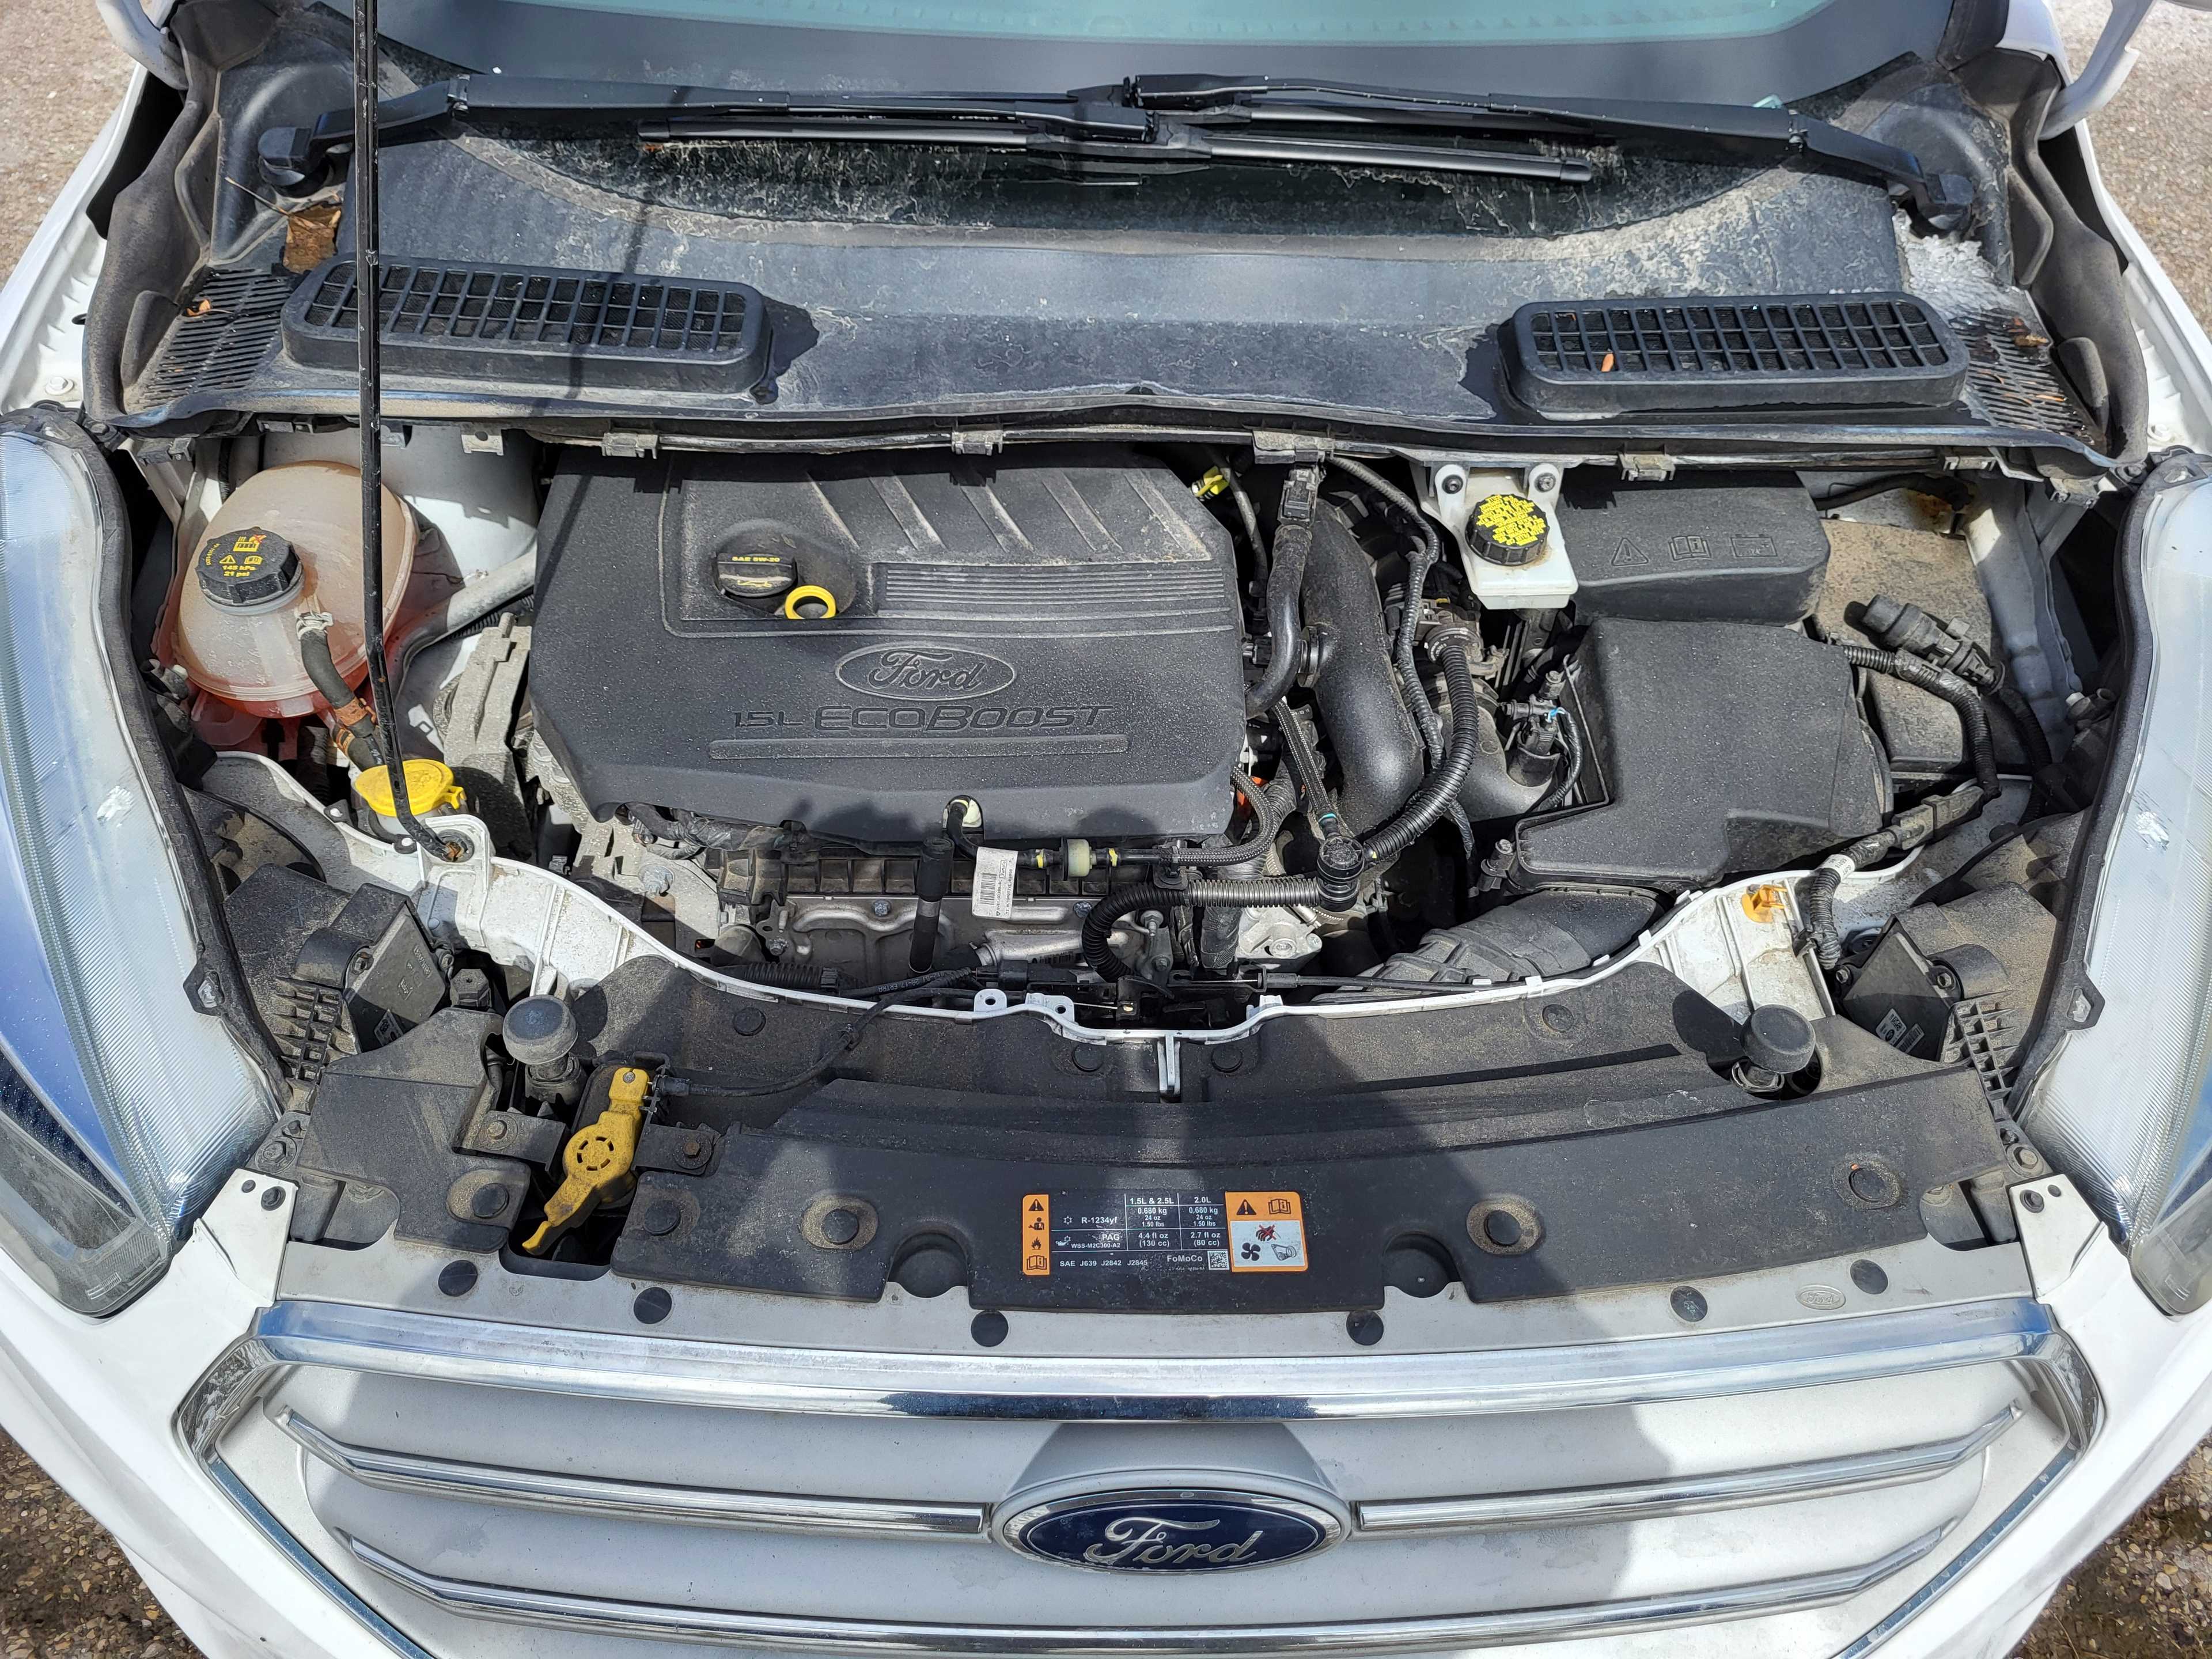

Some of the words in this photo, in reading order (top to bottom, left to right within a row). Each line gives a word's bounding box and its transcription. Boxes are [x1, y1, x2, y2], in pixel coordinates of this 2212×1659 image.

[868, 650, 987, 691] Ford
[1209, 1207, 1218, 1215] kg
[1081, 1217, 1118, 1225] R-1234yf
[1139, 1240, 1156, 1248] (130
[1157, 1240, 1170, 1248] cc)
[1194, 1239, 1206, 1247] (80
[1208, 1239, 1220, 1247] cc)
[1806, 1291, 1835, 1304] Ford
[1084, 1516, 1264, 1566] Ford
